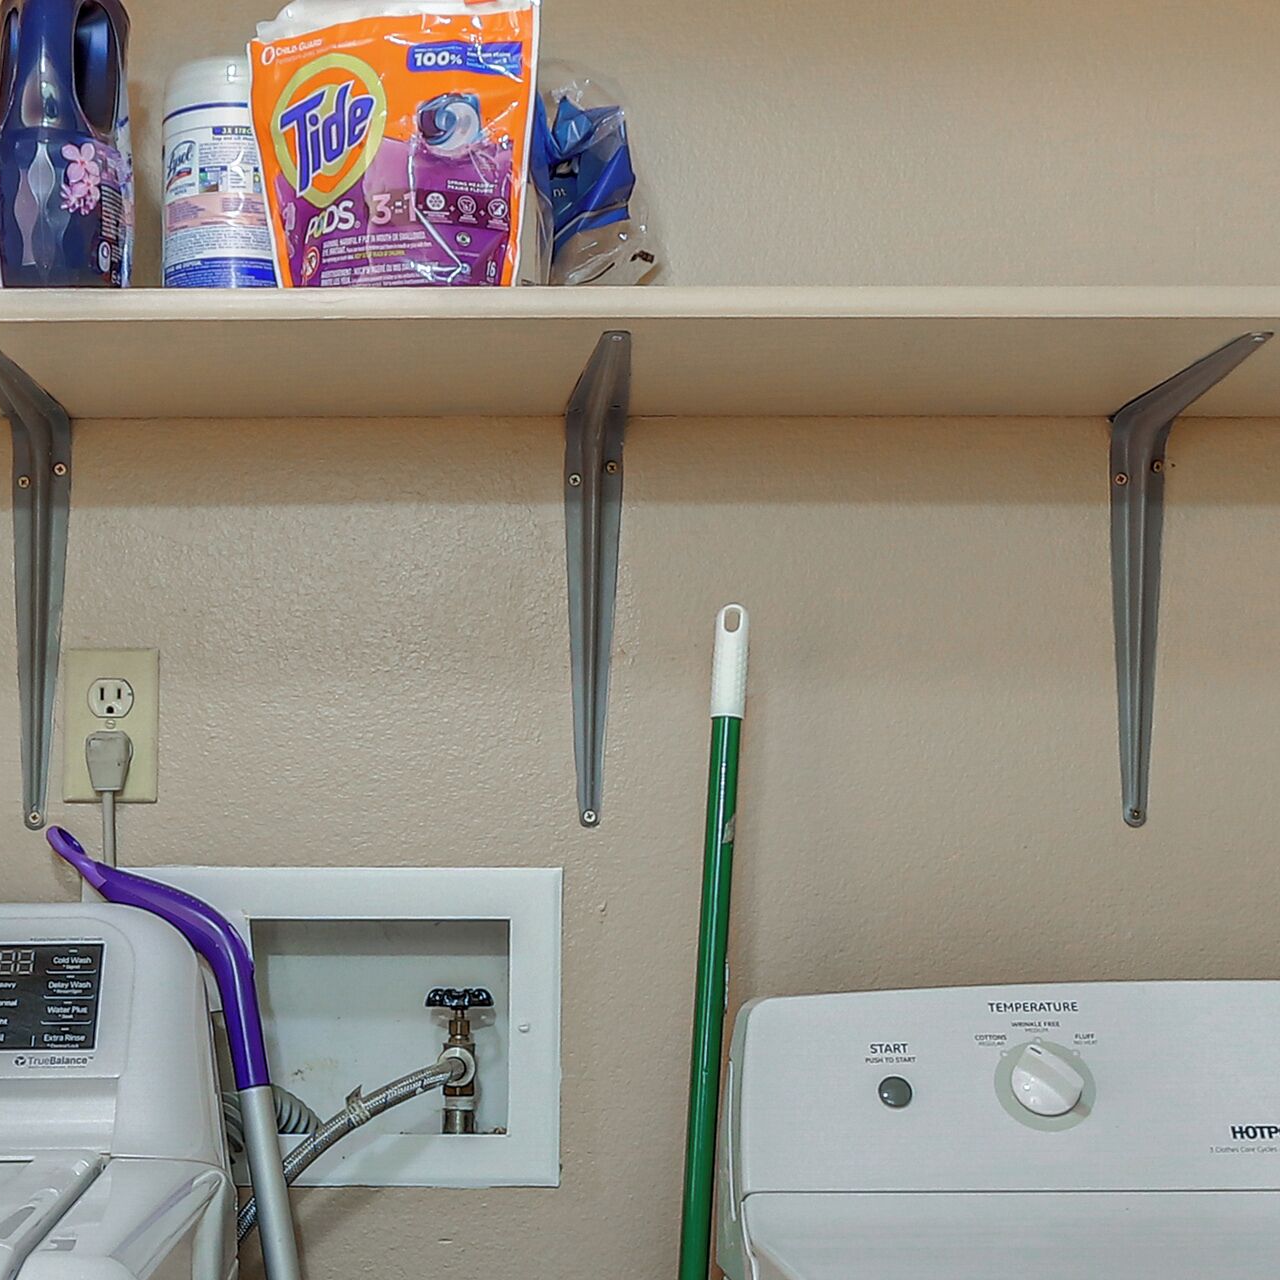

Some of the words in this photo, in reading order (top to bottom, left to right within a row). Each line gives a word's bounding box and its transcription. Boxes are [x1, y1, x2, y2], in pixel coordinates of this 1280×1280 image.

[414, 51, 463, 67] 100%
[280, 81, 374, 196] Tide
[303, 201, 356, 243] PODS
[52, 956, 69, 964] Cold
[70, 956, 92, 964] Wash
[47, 981, 69, 990] Delay
[70, 981, 92, 989] Wash
[47, 1006, 70, 1014] Water
[987, 1001, 1079, 1013] TEMPERATURE
[43, 1034, 64, 1042] Extra
[64, 1034, 86, 1042] Rinse
[869, 1043, 909, 1054] START
[1256, 1146, 1278, 1154] Cycles
